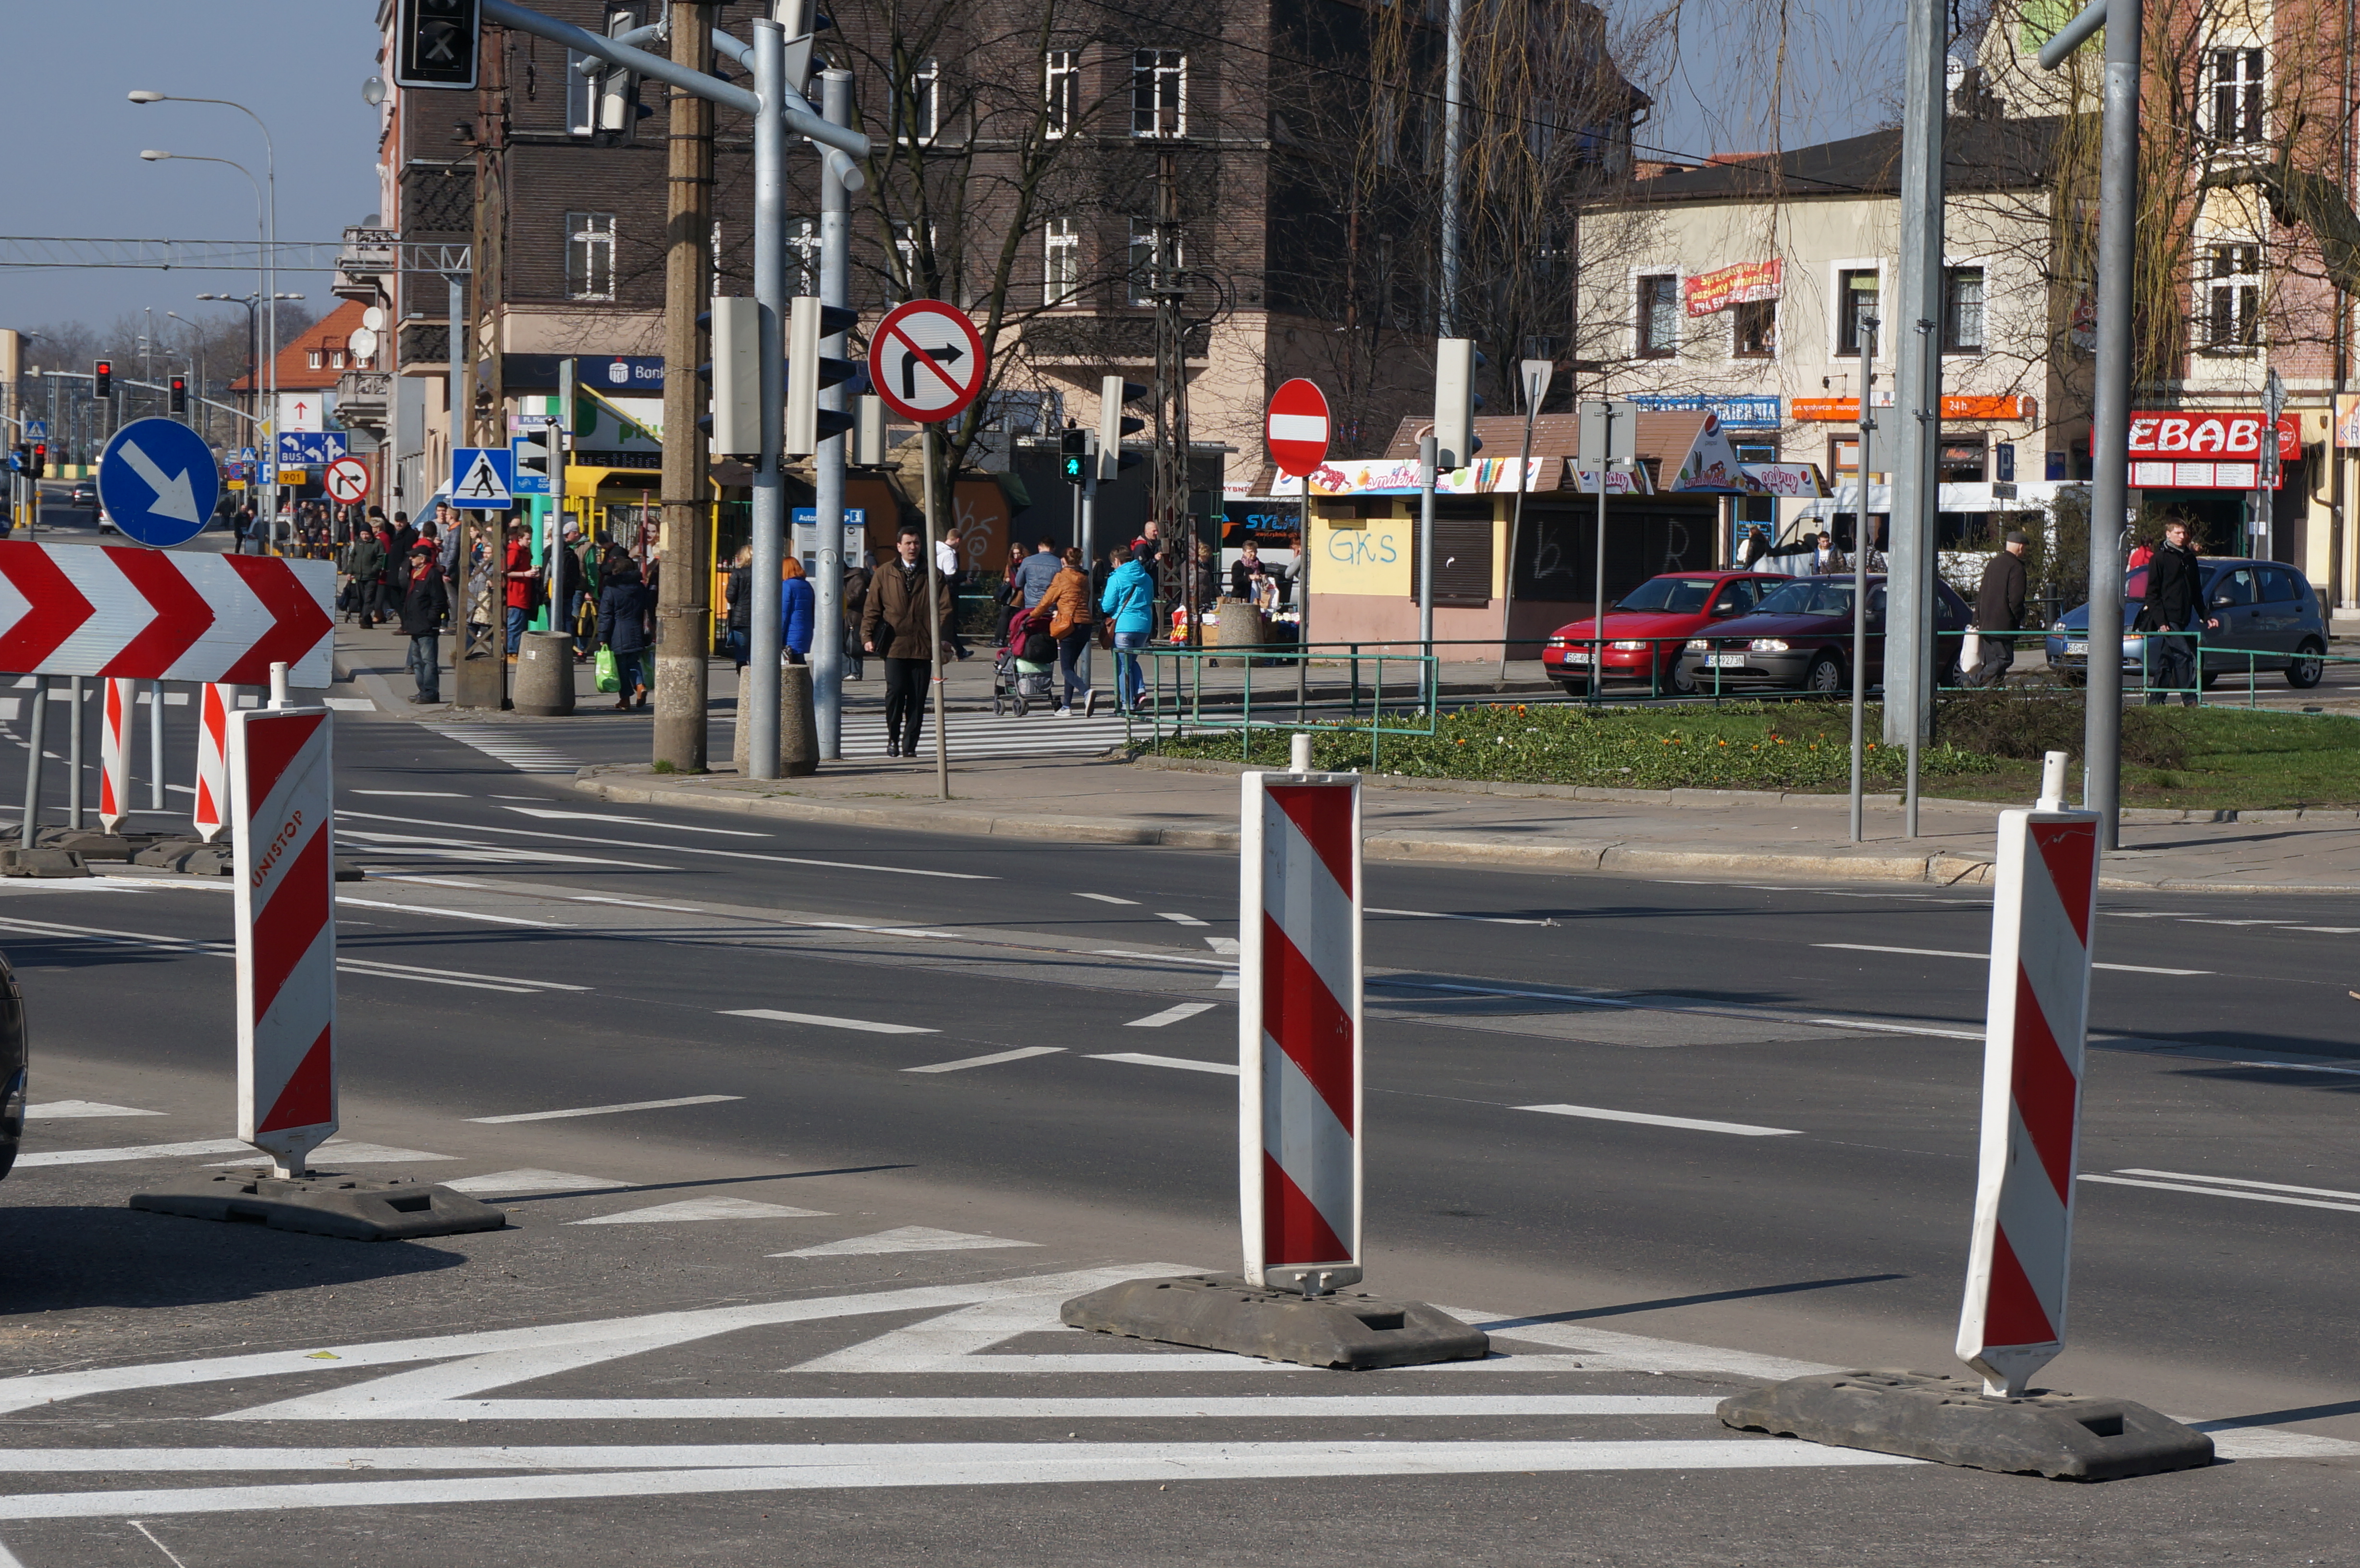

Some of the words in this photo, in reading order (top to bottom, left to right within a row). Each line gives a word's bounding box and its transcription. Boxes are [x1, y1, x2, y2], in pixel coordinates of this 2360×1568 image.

[1949, 401, 1959, 410] 24
[2129, 418, 2259, 452] EBAB
[282, 453, 302, 461] BUS
[1366, 466, 1410, 490] smaki
[1761, 466, 1798, 494] gofry
[1328, 528, 1397, 565] GKS
[251, 810, 302, 888] UNISTOP
